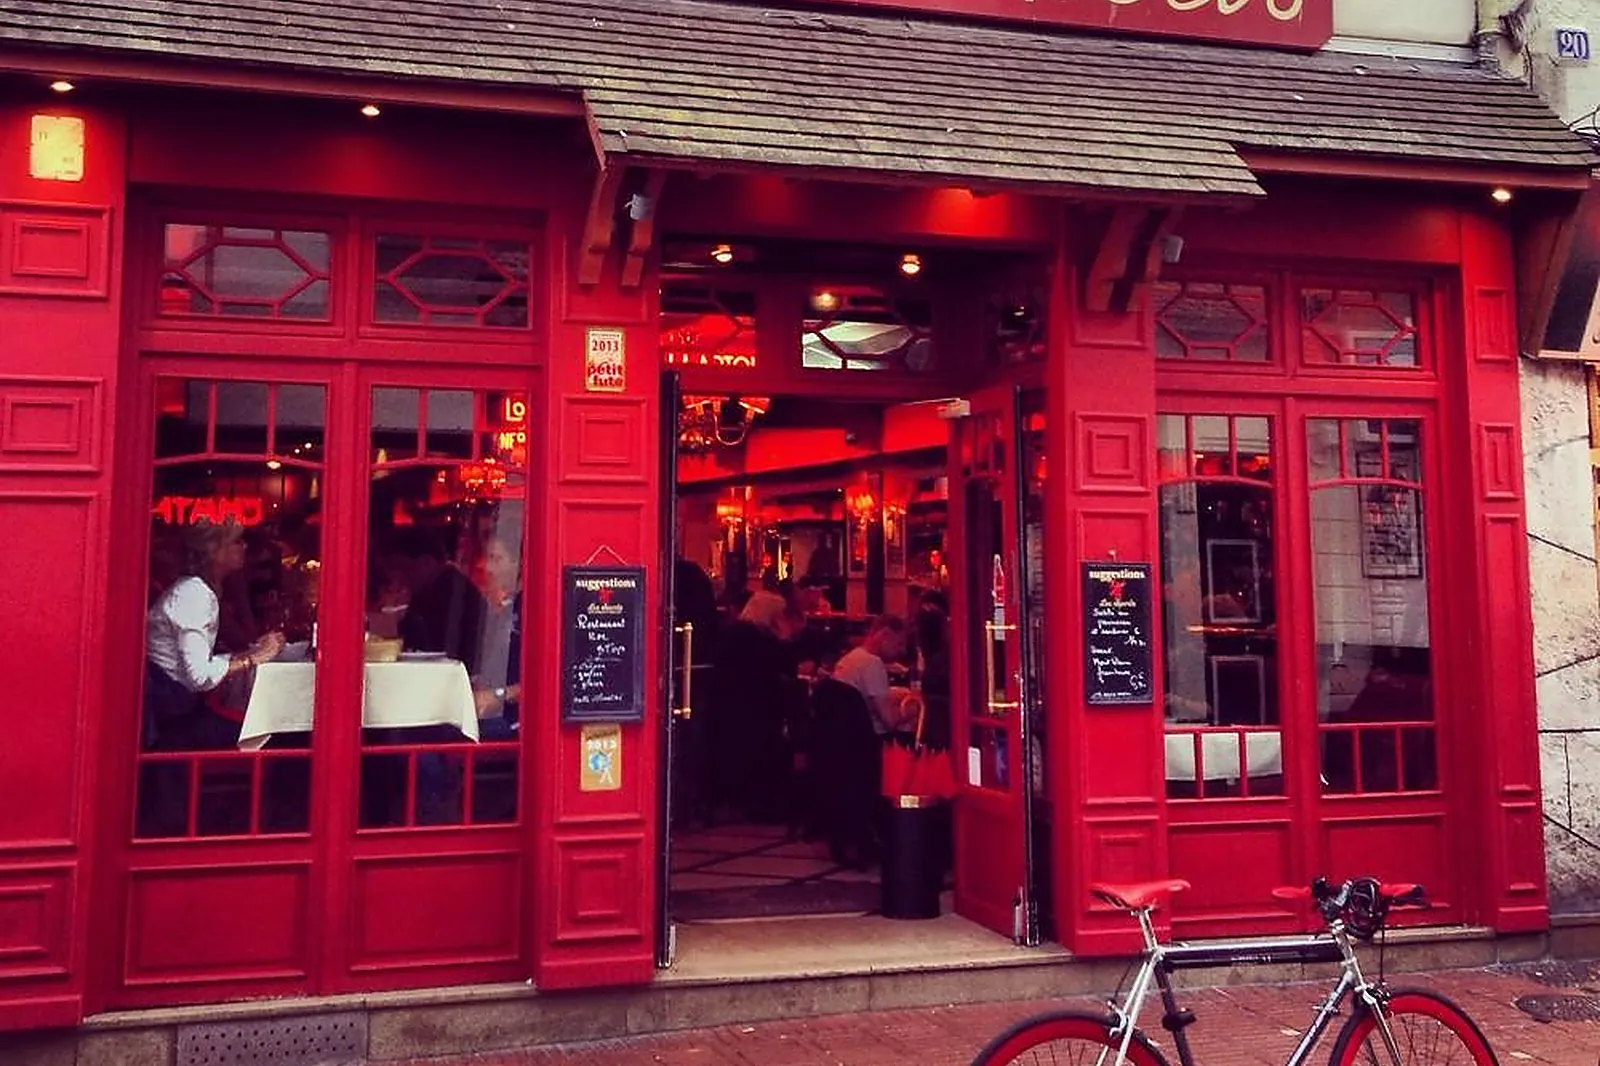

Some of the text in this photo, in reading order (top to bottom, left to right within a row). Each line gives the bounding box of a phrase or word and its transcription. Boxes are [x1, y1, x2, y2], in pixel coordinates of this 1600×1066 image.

[1560, 32, 1586, 57] 20
[592, 339, 619, 352] 2013
[1089, 569, 1146, 583] suggestions
[576, 577, 637, 591] suggestions
